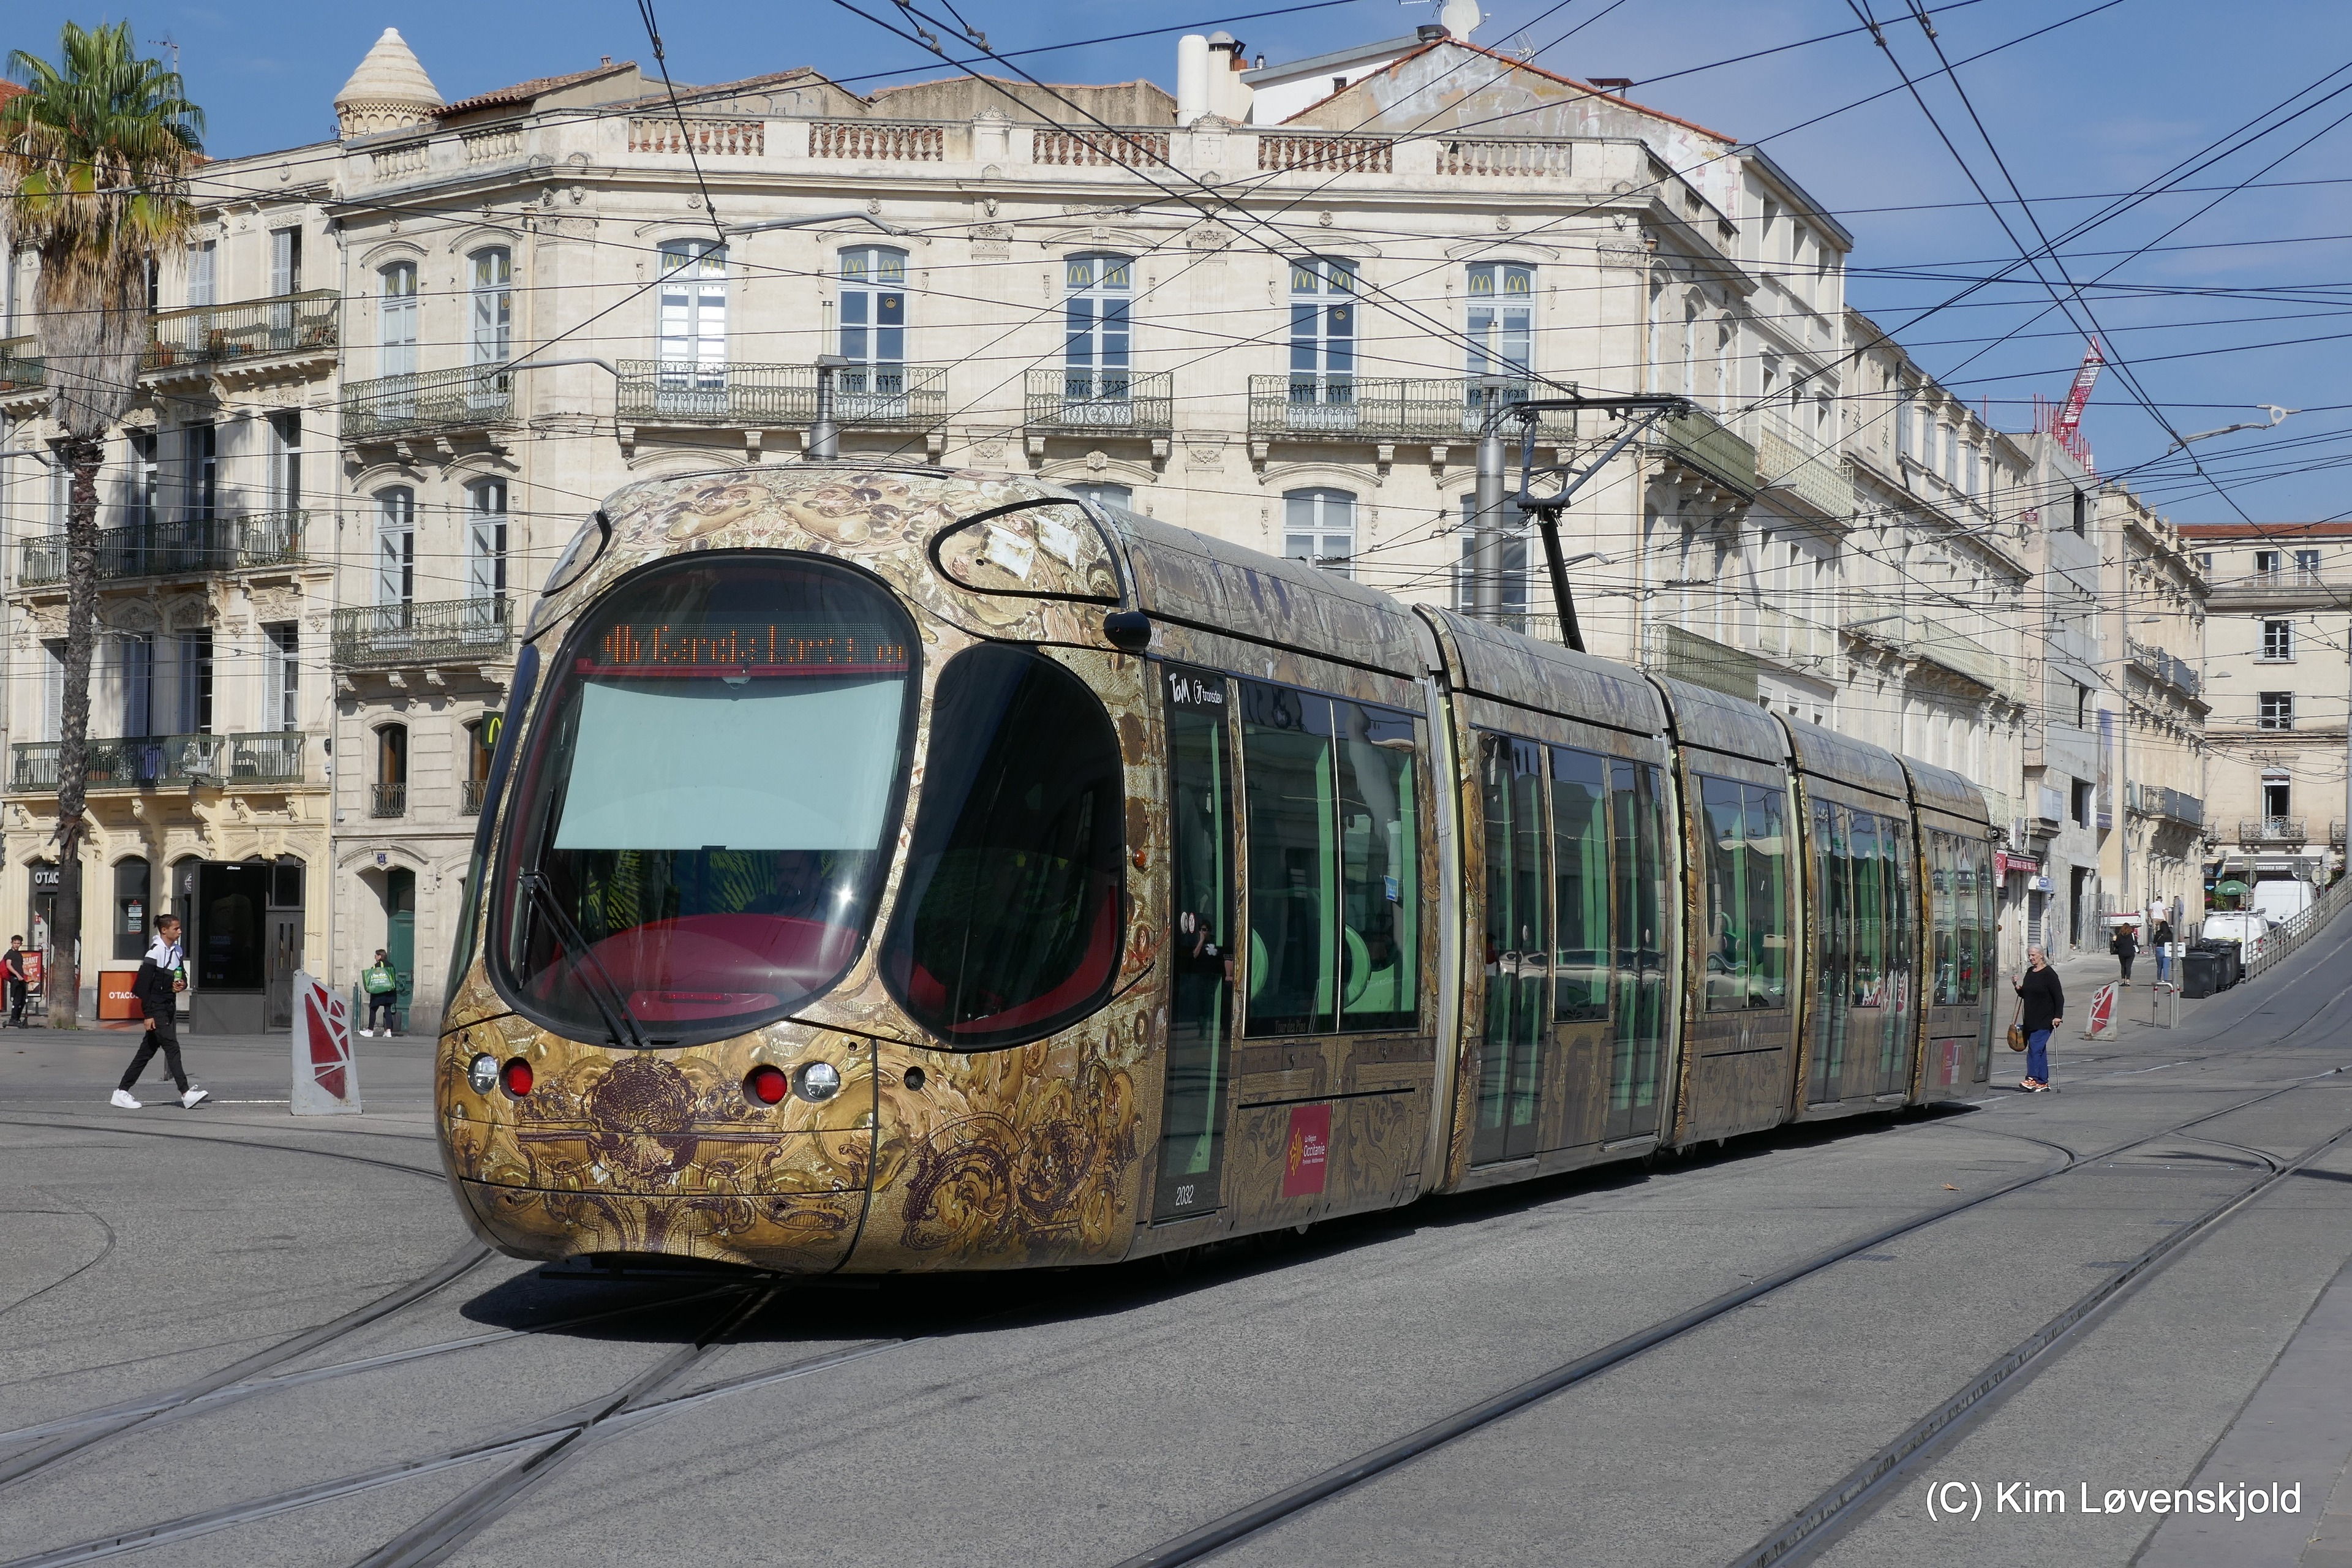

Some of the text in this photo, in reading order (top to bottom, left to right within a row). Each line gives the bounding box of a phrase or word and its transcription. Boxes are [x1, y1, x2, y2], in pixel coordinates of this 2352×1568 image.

[1202, 689, 1223, 704] transdev
[35, 872, 59, 884] O'TAC
[1303, 1142, 1325, 1157] Occitanie
[1175, 1184, 1194, 1206] 2032
